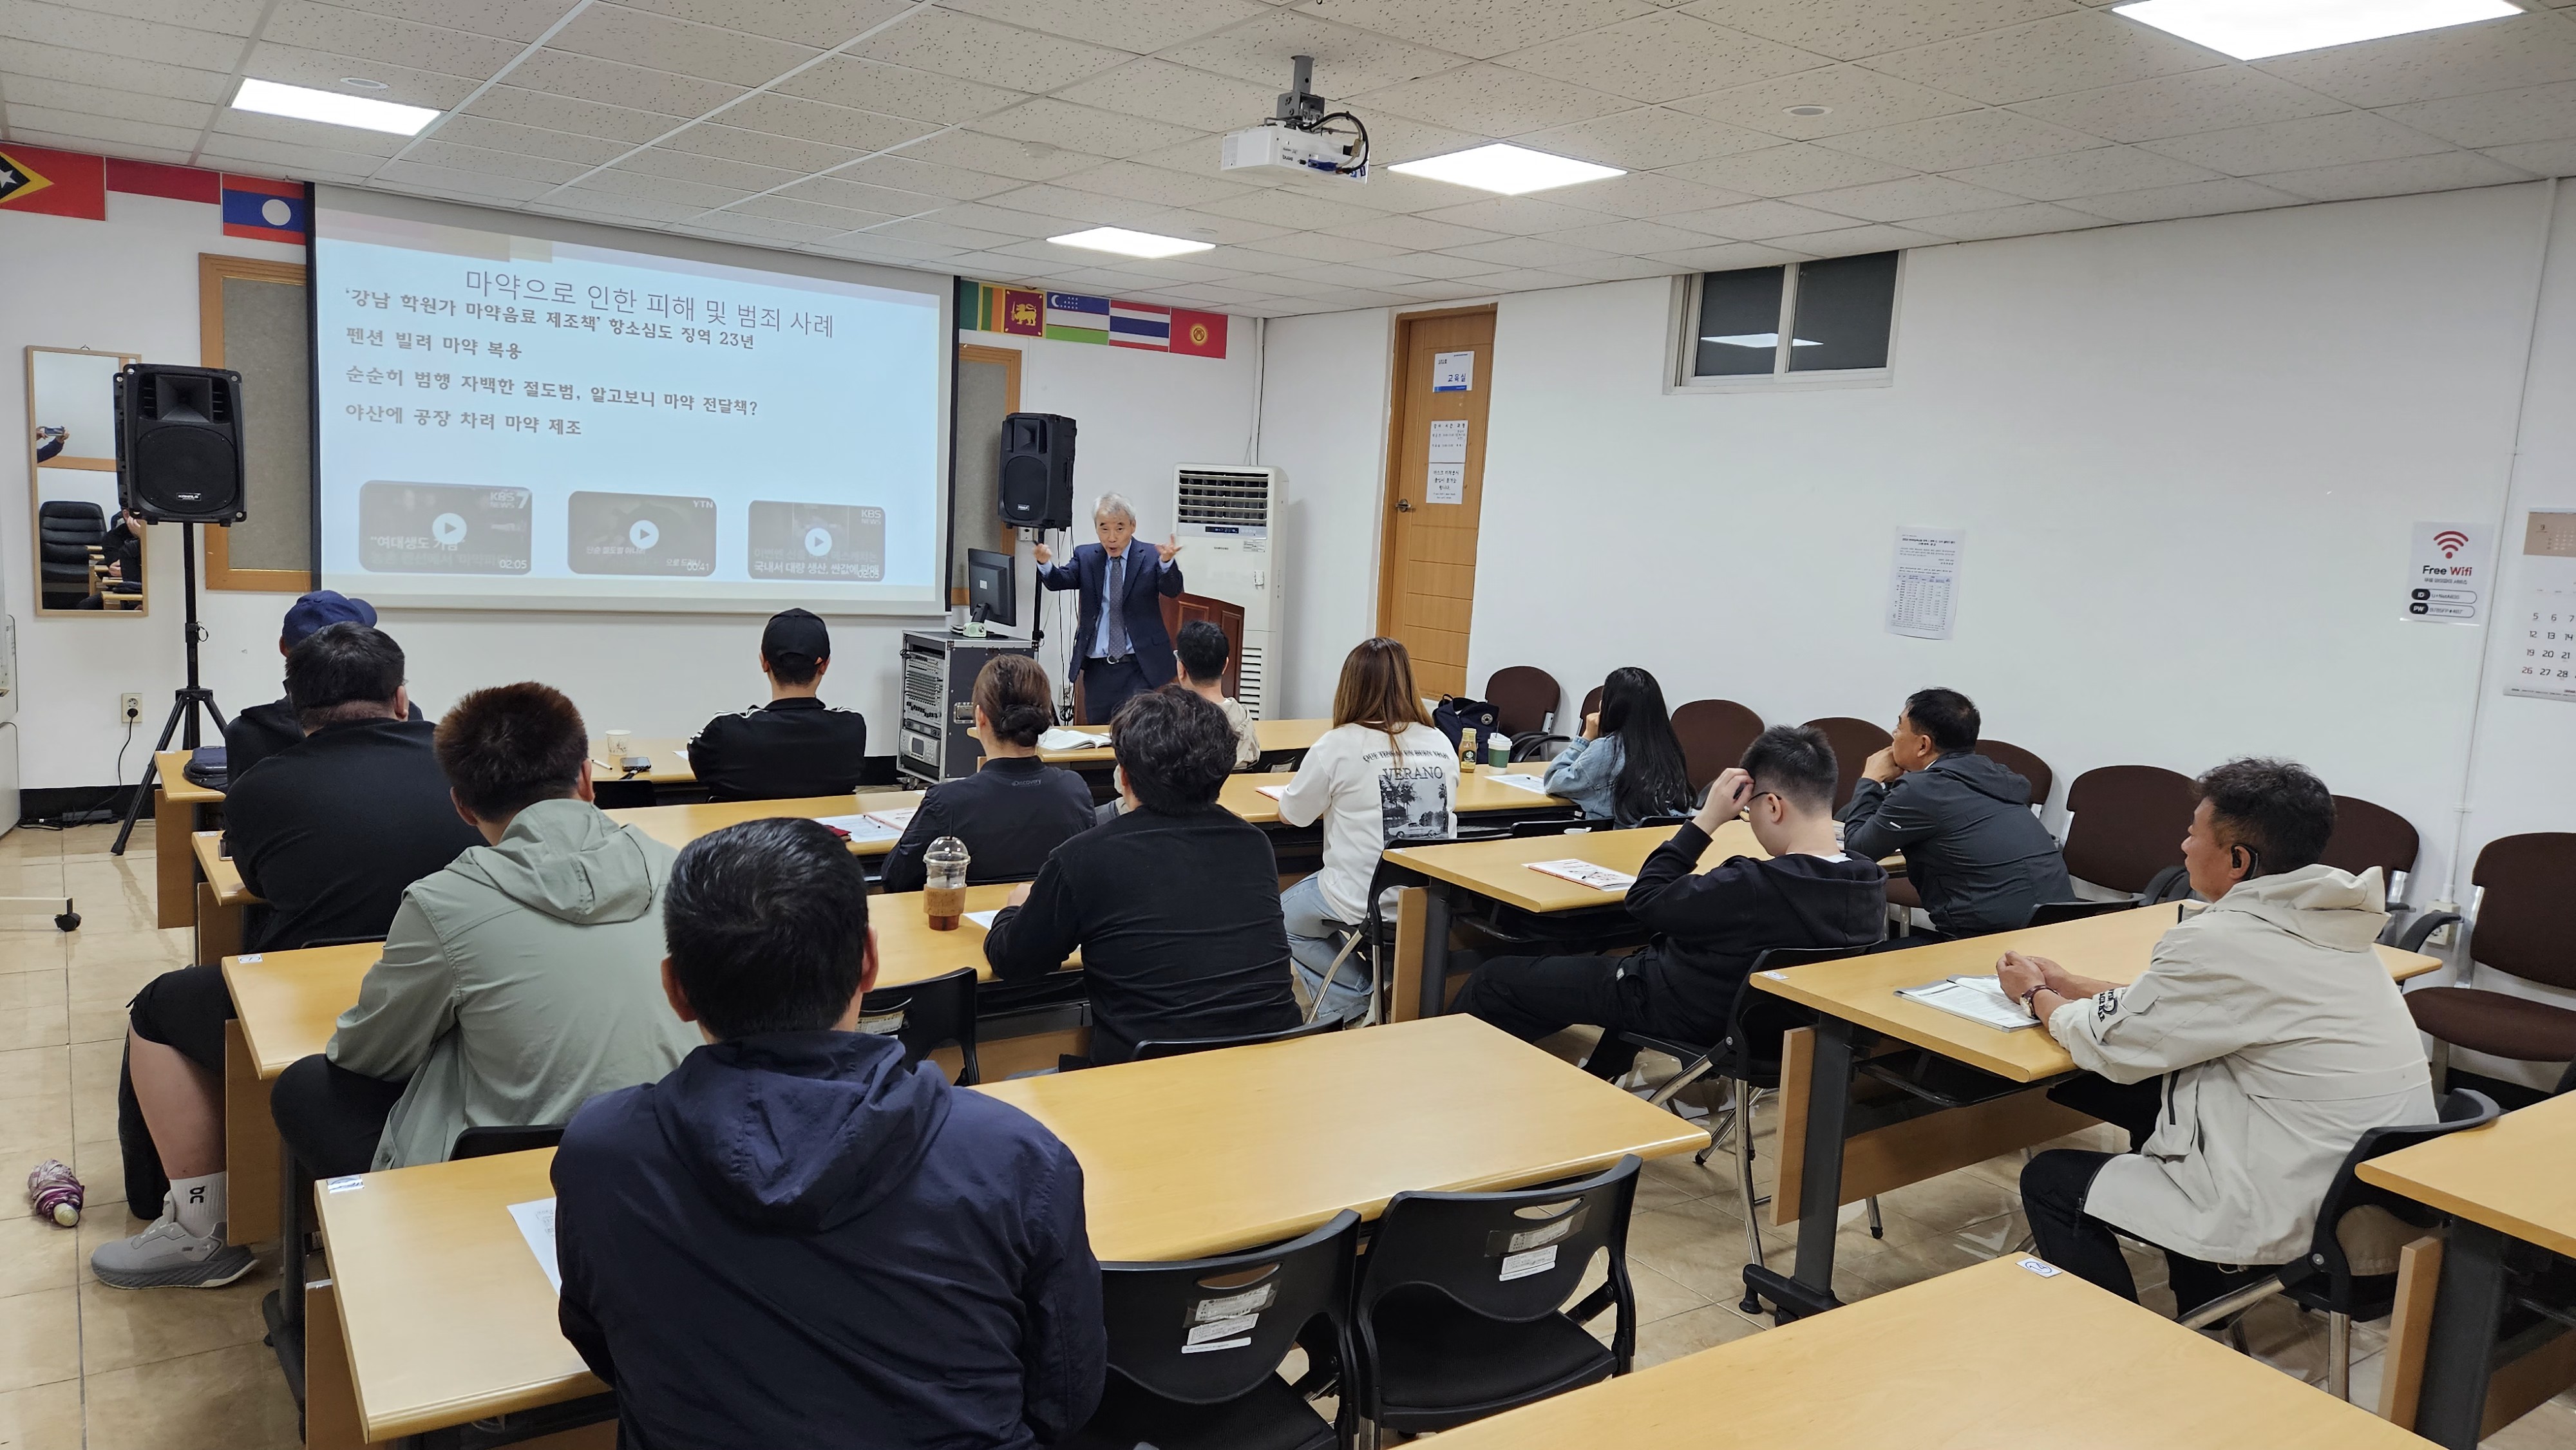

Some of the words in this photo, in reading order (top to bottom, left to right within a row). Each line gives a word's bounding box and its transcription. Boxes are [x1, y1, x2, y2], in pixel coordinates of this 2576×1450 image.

[466, 270, 576, 305] 마약으로
[587, 285, 638, 314] 인한
[647, 292, 696, 322] 피해
[706, 299, 726, 326] 및
[737, 303, 781, 332] 범죄
[790, 311, 834, 339] 사례
[400, 294, 457, 317] 학원가
[466, 302, 536, 325] 마약음료
[608, 317, 673, 340] 항소심도
[681, 326, 711, 346] 징역
[719, 331, 754, 350] 23년
[346, 326, 384, 348] 펜션
[395, 332, 431, 352] 빌려
[442, 337, 478, 355] 마약
[487, 341, 522, 361] 복용
[1448, 373, 1466, 382] 교육실
[346, 365, 403, 387] 순순히
[414, 370, 451, 391] 범행
[460, 375, 515, 395] 자백한
[523, 381, 581, 402] 절도범,
[590, 386, 656, 408] 알고보니
[664, 393, 695, 411] 마약
[703, 396, 758, 416] 전달책?
[345, 403, 403, 425] 야산에
[413, 408, 451, 428] 공장
[460, 412, 495, 430] 차려
[505, 415, 540, 433] 마약
[548, 418, 582, 435] 제조
[490, 491, 515, 501] KBS
[516, 491, 530, 509] 7
[693, 500, 714, 509] YTN
[861, 509, 882, 518] KBS
[499, 559, 527, 570] 02:05
[687, 563, 709, 571] 00:41
[754, 561, 784, 573] 국내서
[785, 561, 805, 574] 대량
[830, 563, 858, 575] 싼값에
[2422, 565, 2447, 576] Free
[2450, 566, 2472, 577] Wifi
[2565, 633, 2573, 641] 14
[2526, 648, 2535, 657] 19
[2542, 650, 2554, 658] 20
[2522, 666, 2533, 675] 26
[2556, 670, 2568, 678] 28
[1382, 766, 1443, 781] VERANO
